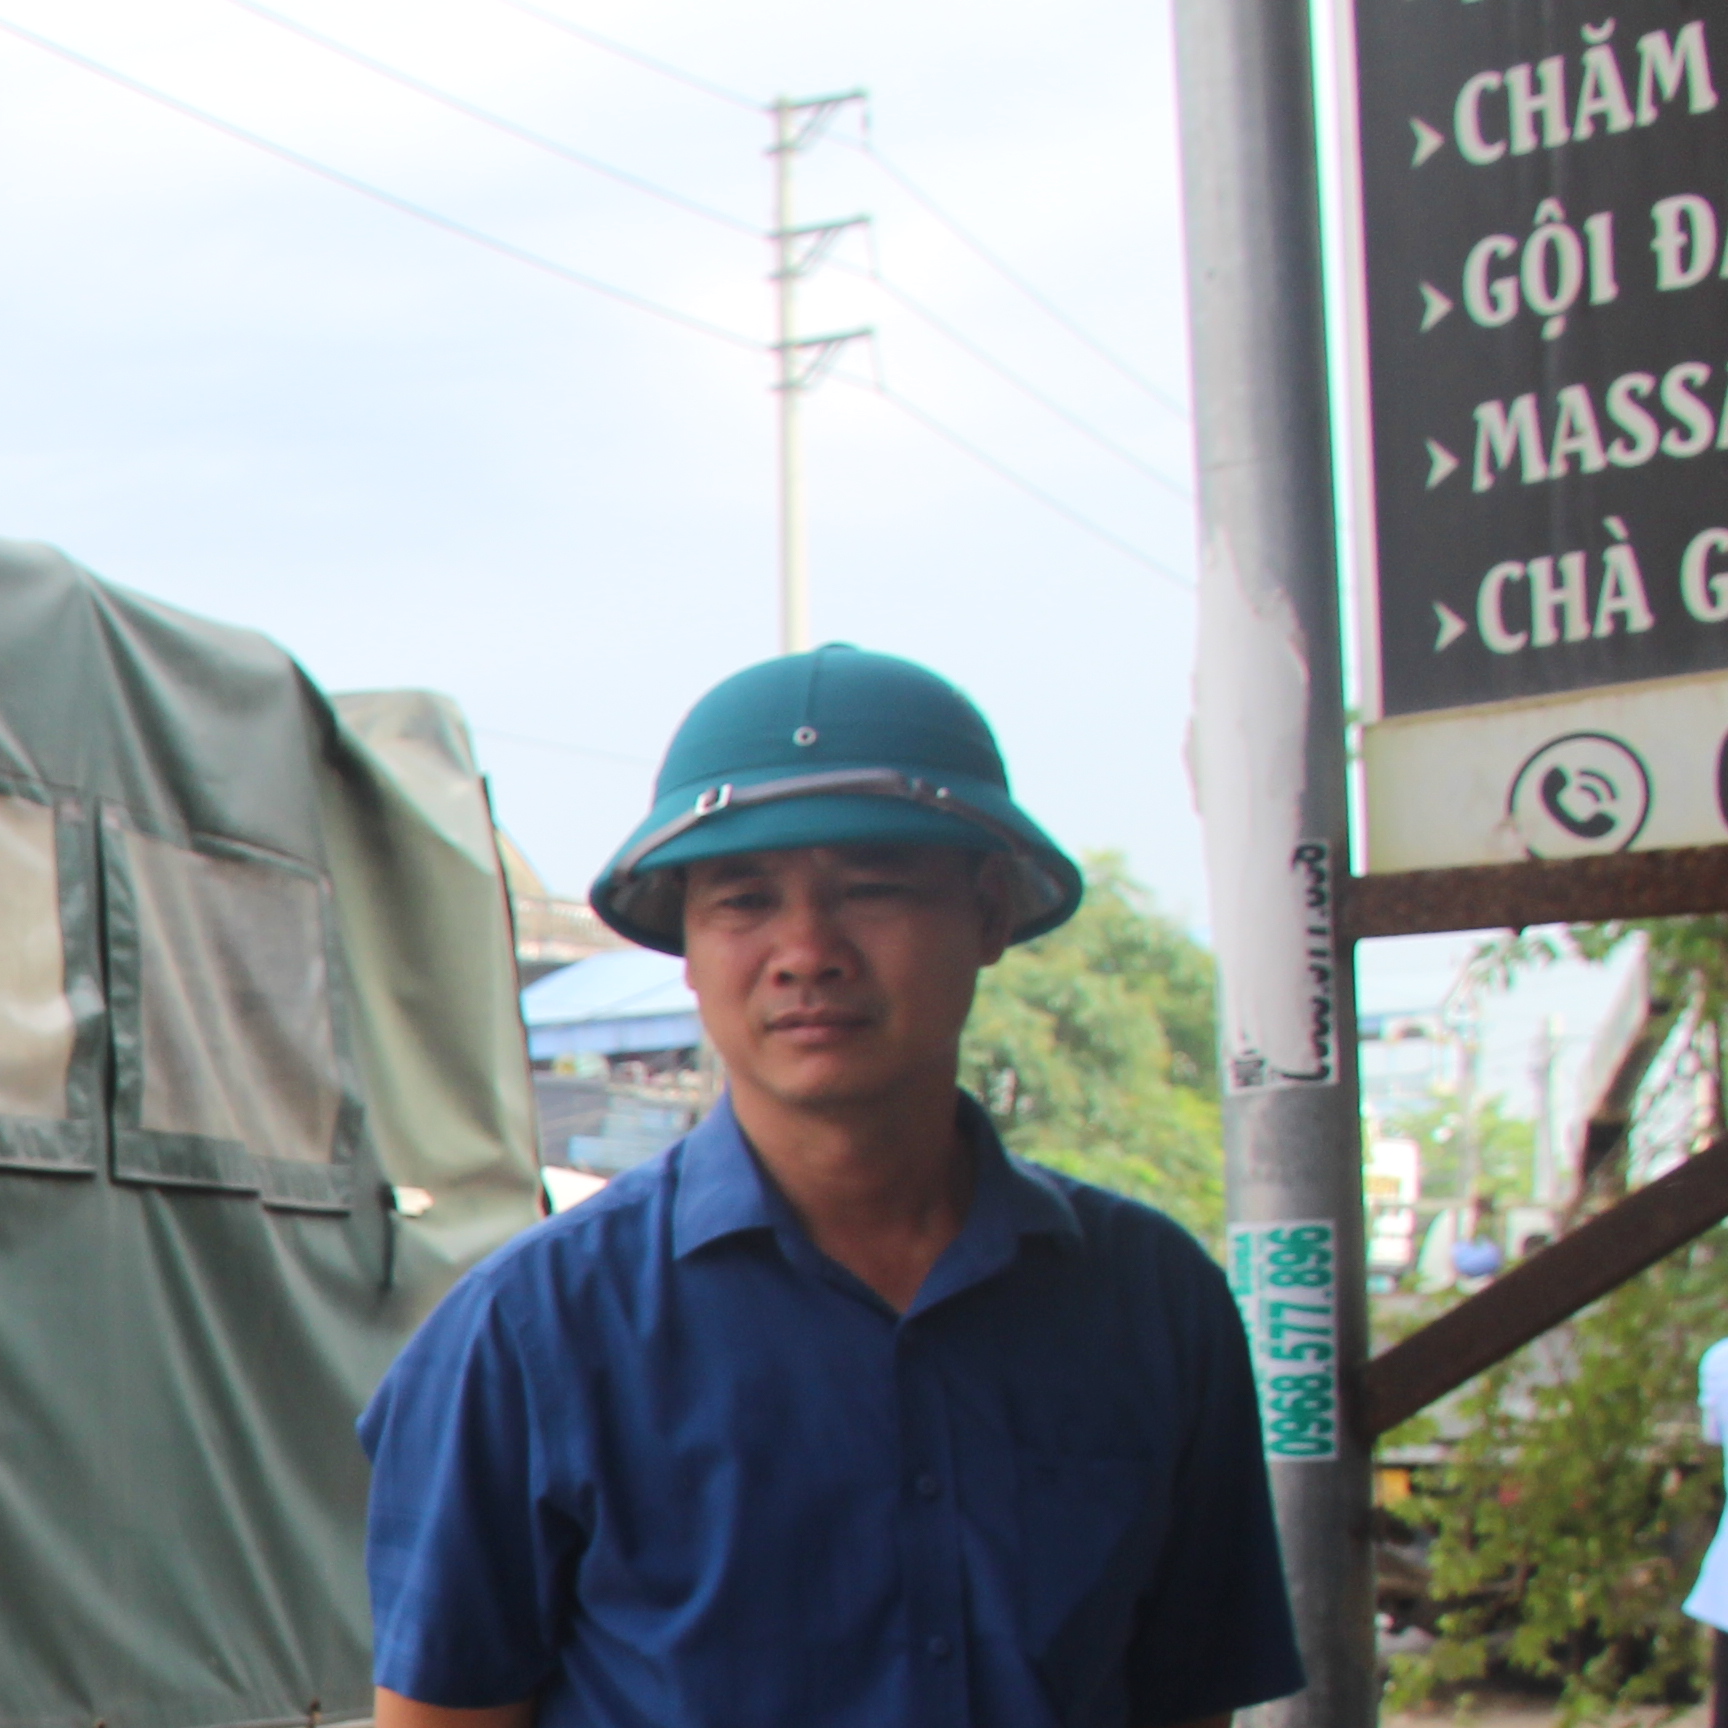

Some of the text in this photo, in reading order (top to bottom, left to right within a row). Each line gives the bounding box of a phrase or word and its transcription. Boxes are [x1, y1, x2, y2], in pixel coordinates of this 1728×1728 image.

[1453, 18, 1718, 167] CHĂM
[1462, 192, 1728, 340] GỘI Đ
[1472, 358, 1728, 493] MASS
[1476, 515, 1655, 655] CHÀ
[1268, 1224, 1335, 1457] 0968.577.896
